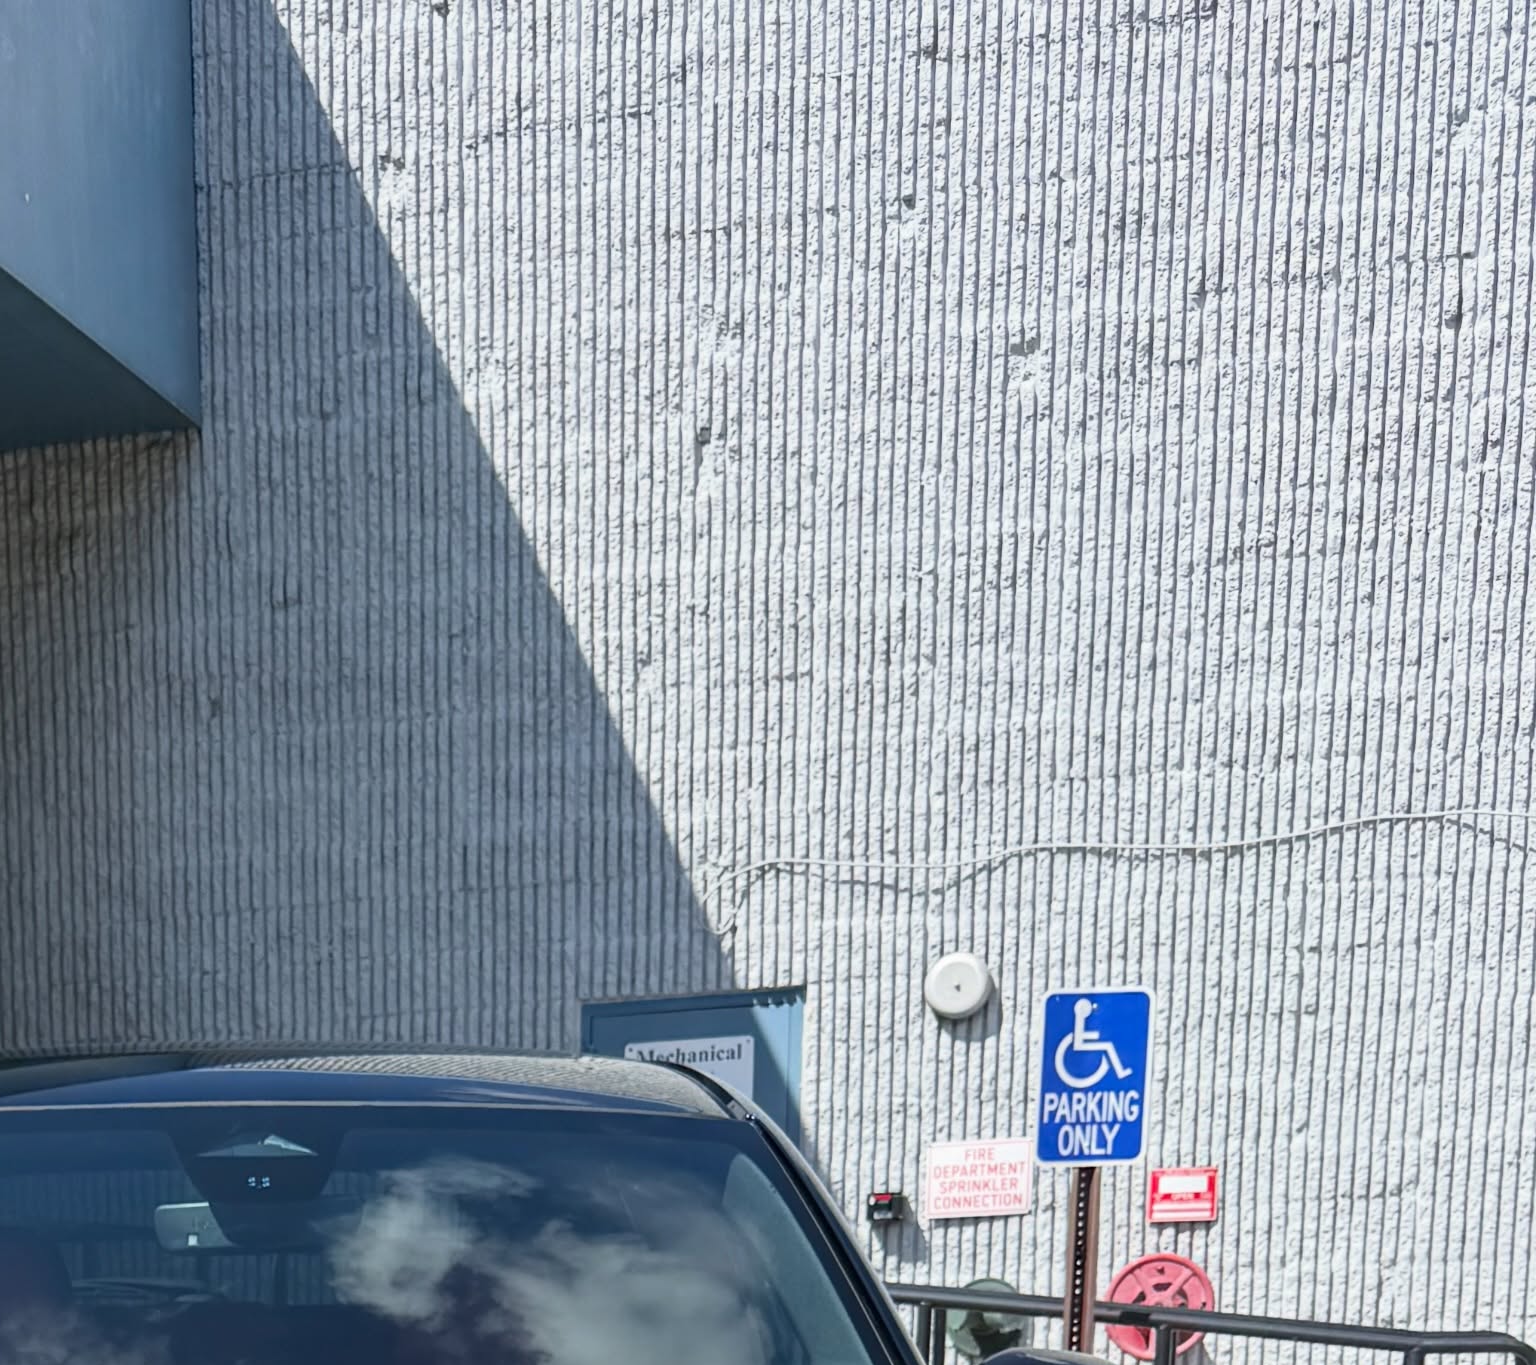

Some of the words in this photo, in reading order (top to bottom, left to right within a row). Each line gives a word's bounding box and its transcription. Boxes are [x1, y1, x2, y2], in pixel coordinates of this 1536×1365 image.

[637, 1043, 742, 1064] Mechanical
[1043, 1090, 1140, 1123] PARKING
[1058, 1123, 1121, 1156] ONLY
[965, 1147, 995, 1161] FIRE
[933, 1161, 1025, 1178] DEPARTMENT
[939, 1177, 1019, 1194] SPRINKLER
[934, 1193, 1023, 1210] CONNECTION
